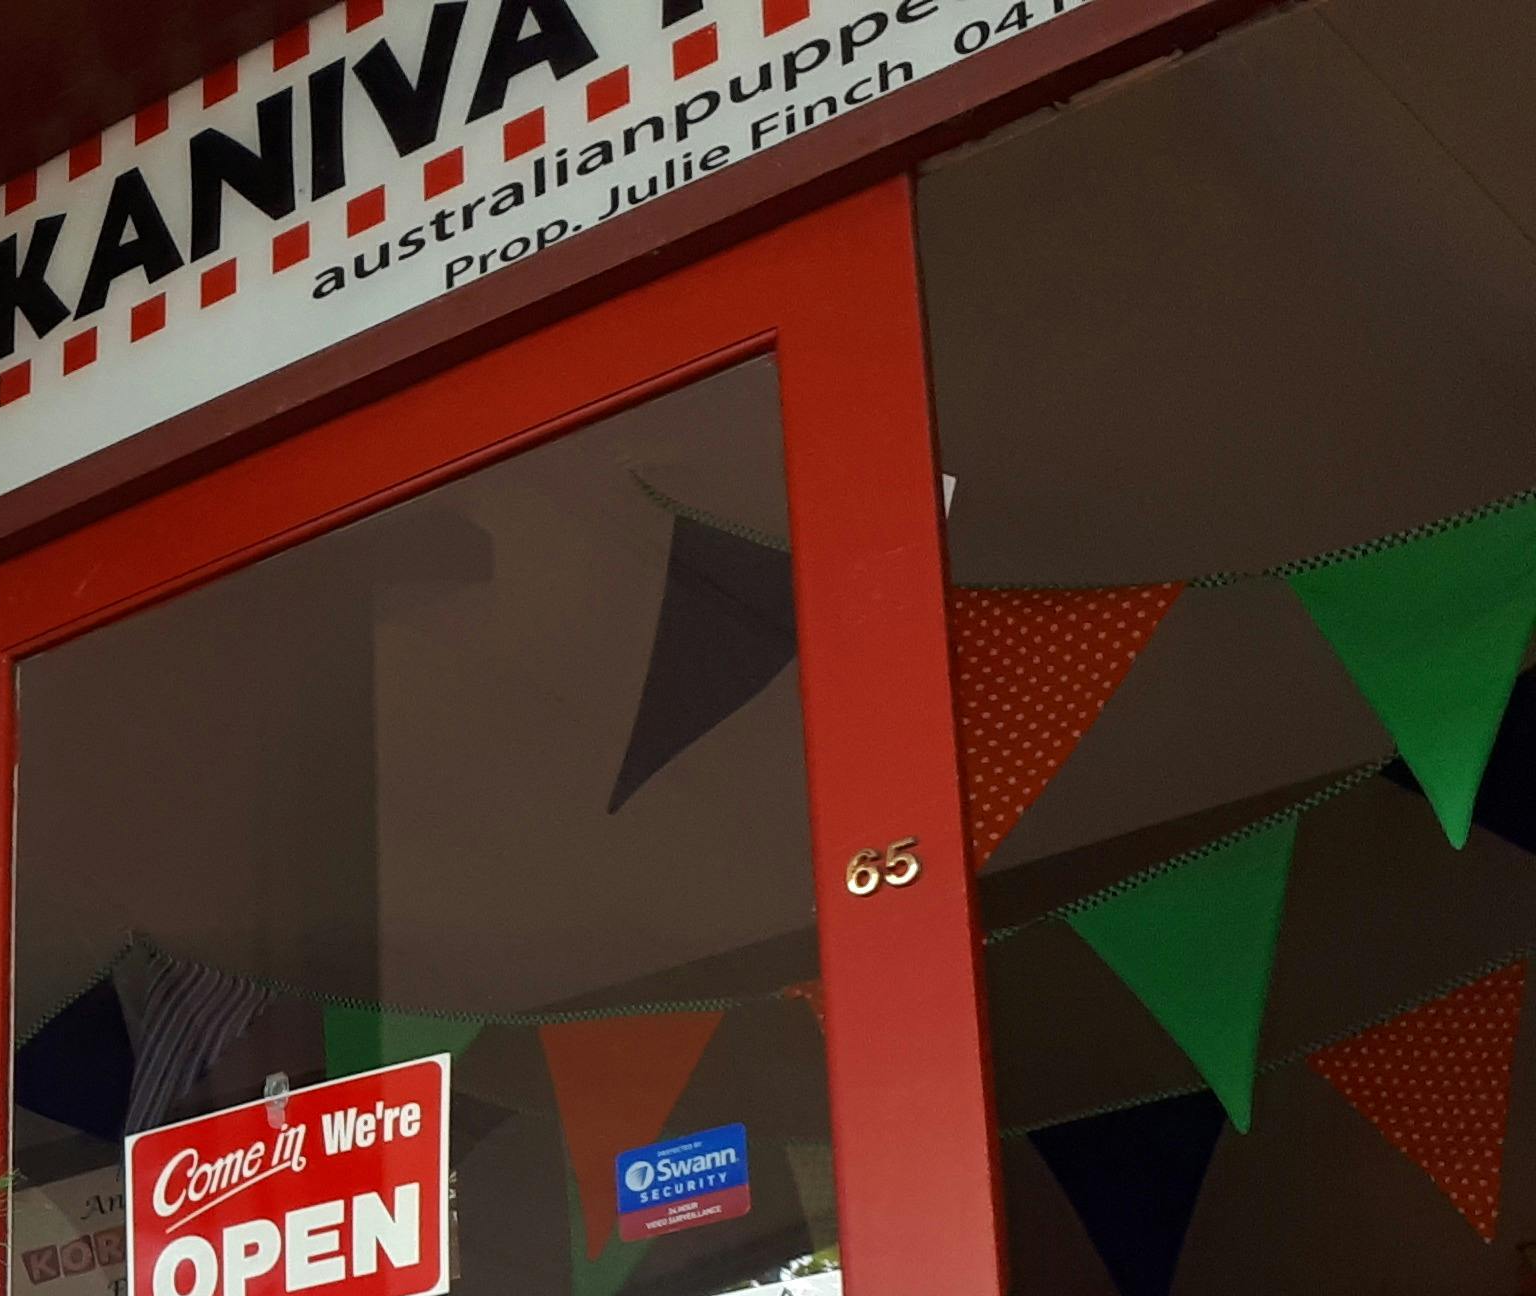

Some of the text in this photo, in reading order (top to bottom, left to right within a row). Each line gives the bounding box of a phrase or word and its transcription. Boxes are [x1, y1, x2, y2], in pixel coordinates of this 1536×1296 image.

[444, 217, 583, 290] Prop.
[598, 142, 731, 221] Julie
[750, 58, 915, 151] Finch
[846, 836, 919, 895] 65
[153, 1100, 422, 1217] Come in We're
[656, 1147, 737, 1182] Swann
[639, 1171, 728, 1203] SECURITY
[27, 1230, 125, 1283] KOR
